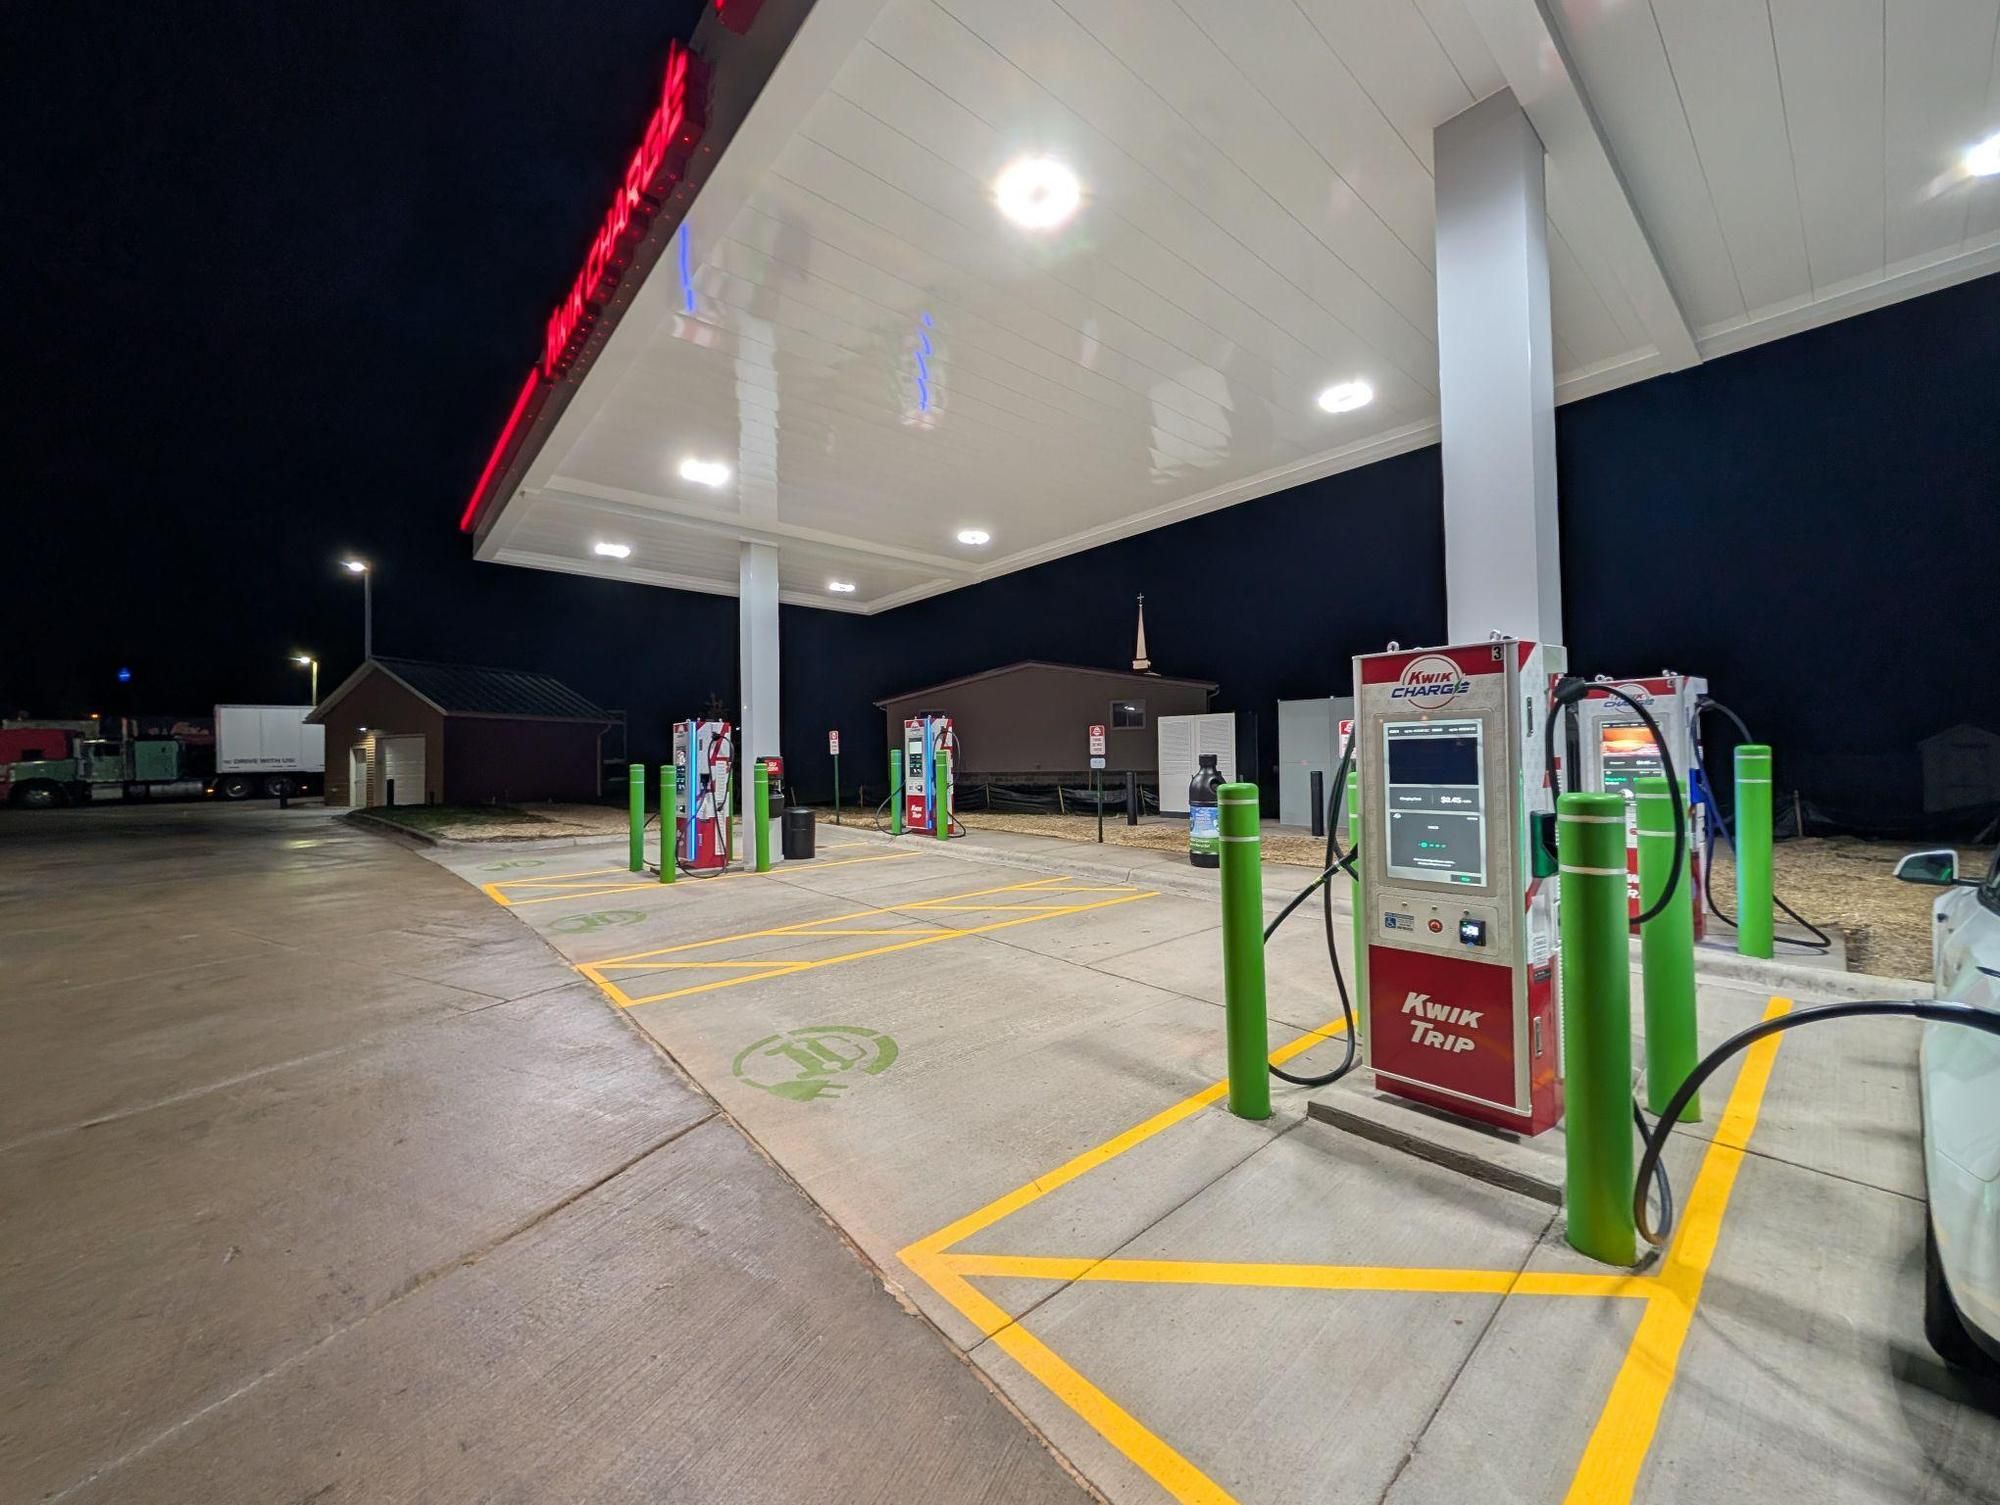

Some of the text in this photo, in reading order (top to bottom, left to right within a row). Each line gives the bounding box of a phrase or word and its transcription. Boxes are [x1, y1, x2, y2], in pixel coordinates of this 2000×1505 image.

[1493, 646, 1502, 660] 3
[1408, 671, 1454, 685] KWIK
[1391, 681, 1471, 698] CHARGE
[1401, 991, 1485, 1029] KWIK
[1410, 1019, 1476, 1053] TRIP
